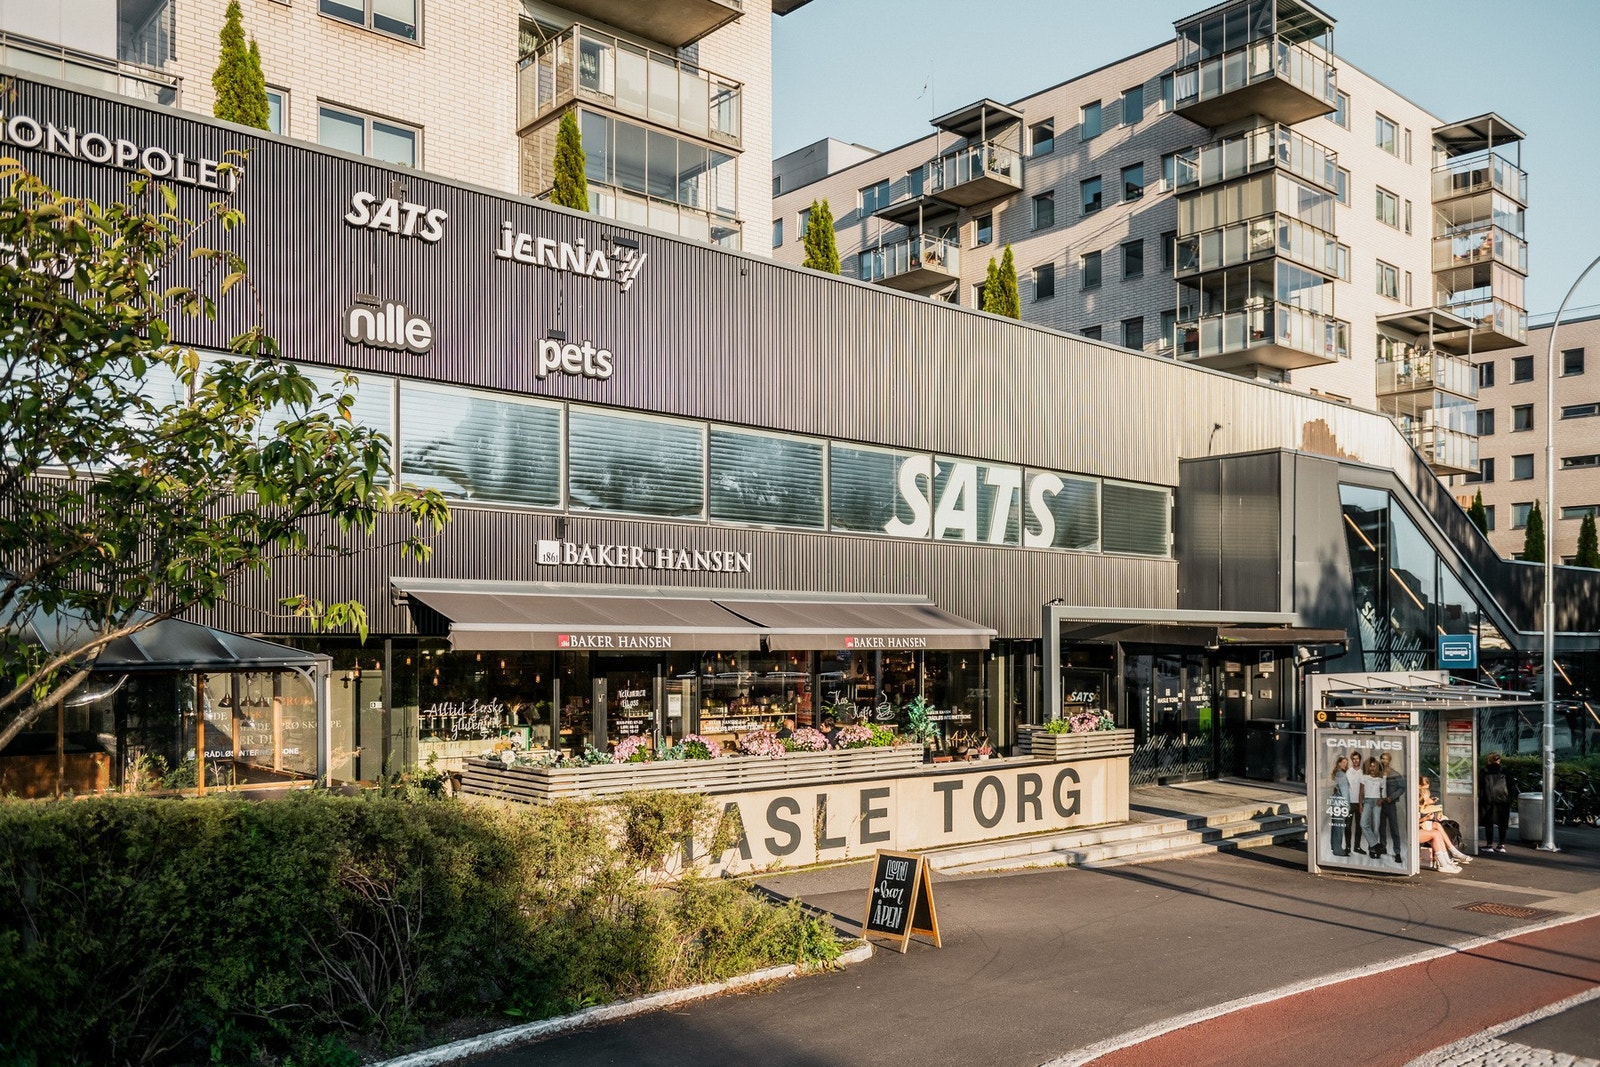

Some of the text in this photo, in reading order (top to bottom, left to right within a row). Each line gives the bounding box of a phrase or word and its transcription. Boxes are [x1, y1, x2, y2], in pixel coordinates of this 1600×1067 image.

[0, 113, 244, 192] ONOPOLET
[345, 191, 448, 242] SATS
[350, 302, 431, 348] nille
[537, 339, 613, 380] pets
[883, 455, 1065, 548] SATS
[563, 542, 752, 573] BAKER HANSEN
[569, 635, 614, 647] BAKER
[618, 636, 672, 648] HANSEN
[853, 637, 885, 648] BAKER
[888, 637, 927, 648] HANSEN
[423, 702, 466, 718] Alltid
[1071, 691, 1095, 702] SATS
[203, 748, 234, 758] RÅDLØS
[1326, 738, 1403, 750] CARLINGS
[933, 768, 1082, 833] TORG
[880, 880, 904, 905] bar
[872, 899, 903, 929] ÅPEN
